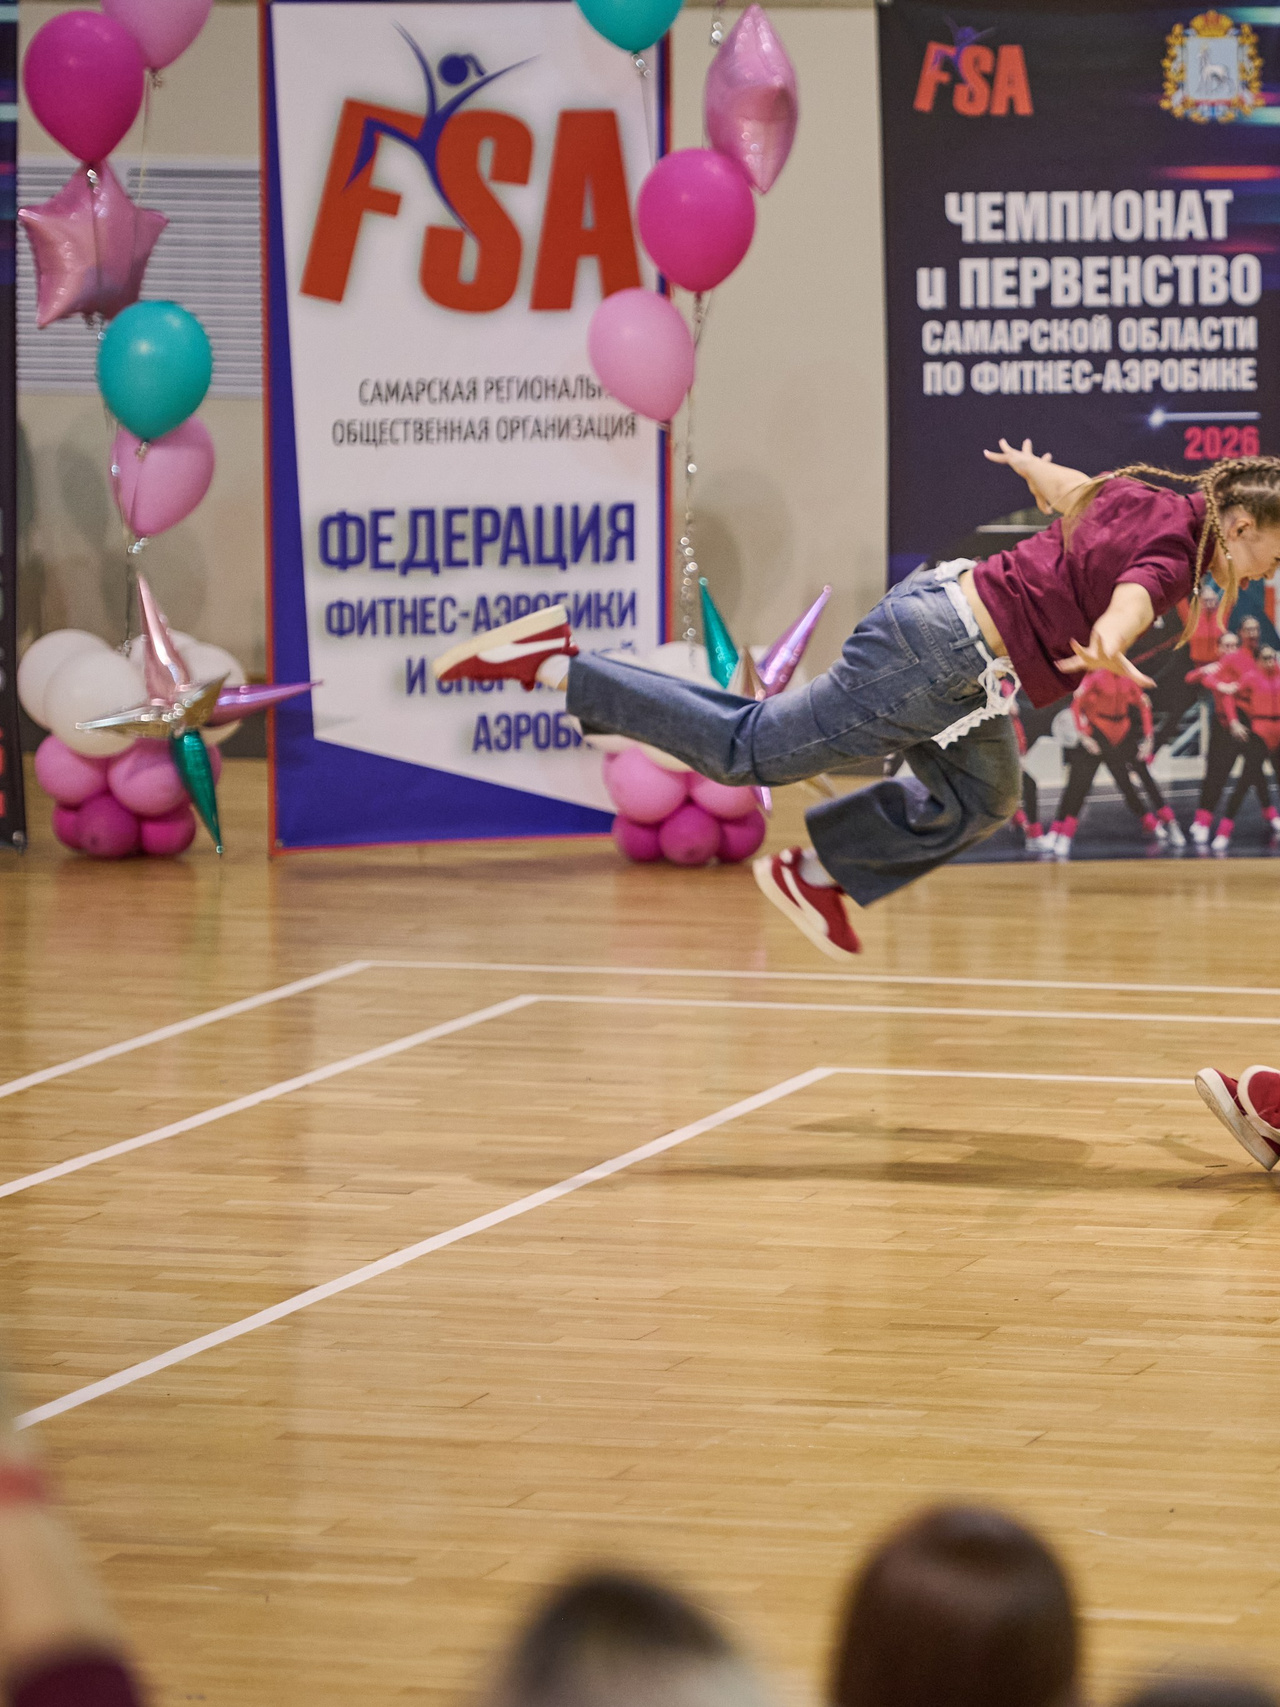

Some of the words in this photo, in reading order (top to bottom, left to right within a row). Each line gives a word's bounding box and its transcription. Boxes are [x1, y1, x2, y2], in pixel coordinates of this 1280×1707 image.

[913, 41, 1034, 116] FSA
[299, 97, 642, 314] FSA
[944, 189, 1235, 243] ЧЕМПИОНАТ
[958, 253, 1262, 309] ПЕРВЕНСТВО
[921, 314, 1112, 355] САМАРСКОЙ
[1118, 316, 1258, 353] ОБЛАСТИ
[358, 375, 478, 406] САМАРСКАЯ
[484, 373, 608, 403] РЕГИОНАЛЬ
[922, 361, 965, 395] ПО
[970, 358, 1258, 395] ФИТНЕС-АЭРОБИКЕ
[332, 415, 489, 447] ОБЩЕСТВЕННАЯ
[496, 412, 637, 443] ОРГАНИЗАЦИЯ
[1183, 425, 1260, 460] 2026
[318, 502, 636, 576] ФЕДЕРАЦИЯ
[405, 657, 427, 696] И
[471, 710, 592, 753] АЭРОБ
